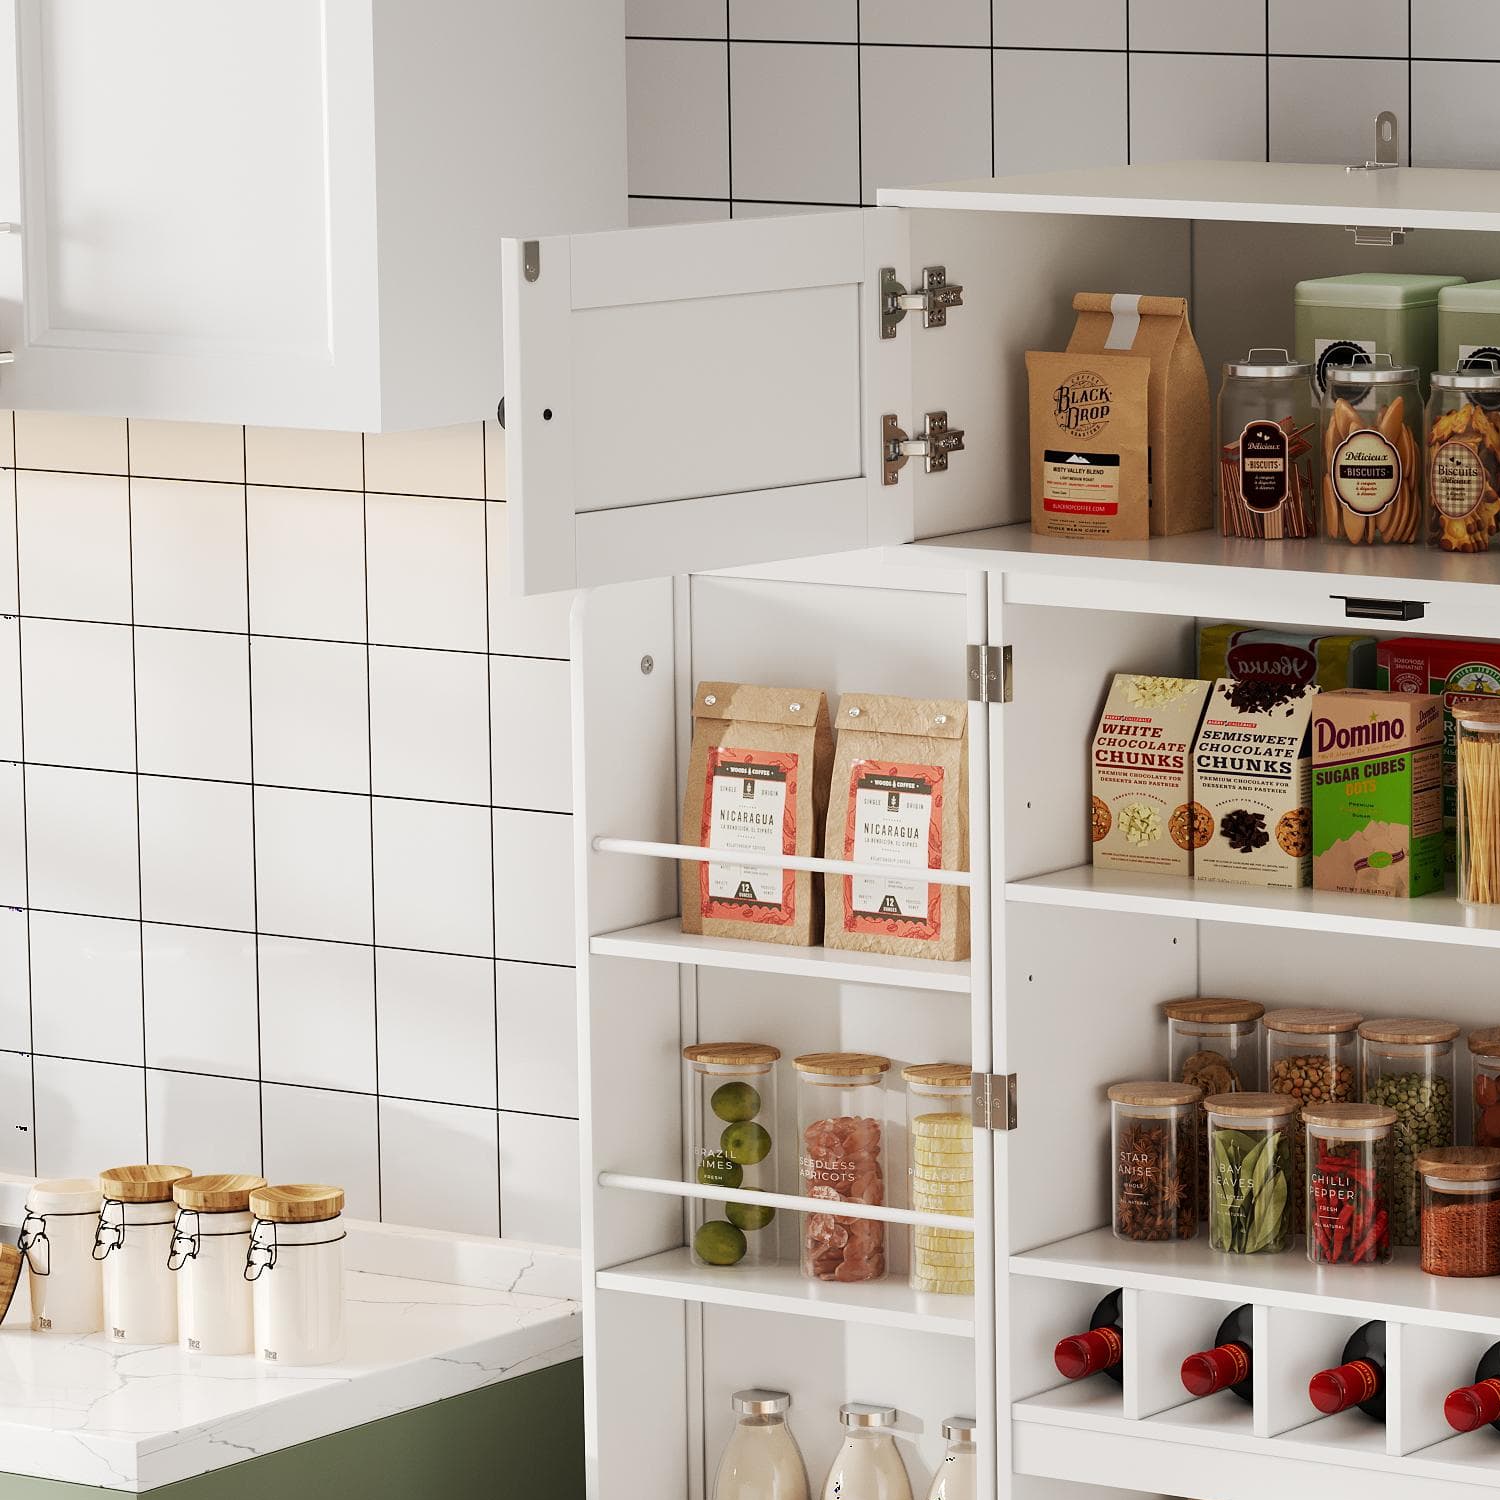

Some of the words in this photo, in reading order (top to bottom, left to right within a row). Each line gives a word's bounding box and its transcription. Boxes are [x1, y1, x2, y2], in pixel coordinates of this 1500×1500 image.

[1053, 385, 1111, 413] BLACK
[1060, 405, 1110, 431] DROP
[1345, 451, 1389, 461] Délicieux
[1067, 467, 1085, 475] VALLEY
[1250, 460, 1278, 470] BISCUITS
[1347, 466, 1386, 477] BISCUITS
[1438, 464, 1478, 477] Biscuits
[1102, 723, 1163, 738] WHITE
[1314, 717, 1405, 753] Domino
[1097, 736, 1187, 752] CHOCOLATE
[1202, 730, 1298, 746] SEMISWEET
[1198, 742, 1295, 758] CHOCOLATE
[1095, 749, 1184, 768] CHUNKS
[1196, 754, 1292, 774] CHUNKS
[1129, 772, 1167, 780] CHOCOLATE
[1316, 766, 1360, 786] SUGAR
[1364, 757, 1406, 778] CUBES
[1100, 776, 1132, 784] DESSERTS
[1202, 782, 1236, 790] DESSERTS
[1233, 778, 1274, 787] CHOCOLATE
[720, 809, 774, 826] NICARAGUA
[864, 822, 920, 839] NICARAGUA
[741, 883, 750, 892] 12
[885, 898, 895, 907] 12
[695, 1147, 737, 1160] BRAZIL
[1120, 1151, 1148, 1163] STAR
[799, 1156, 856, 1171] SEEDLESS
[1220, 1163, 1242, 1174] BAY
[799, 1169, 856, 1182] APRICOTS
[1118, 1164, 1152, 1177] ANISE
[1212, 1176, 1254, 1188] LEAVES
[1311, 1173, 1350, 1187] CHILLI
[1309, 1185, 1354, 1200] PEPPER
[1320, 1205, 1338, 1213] FRESH
[38, 1316, 52, 1329] Tea
[112, 1327, 126, 1338] Tea
[188, 1338, 200, 1350] Tea
[264, 1349, 277, 1360] Tea
